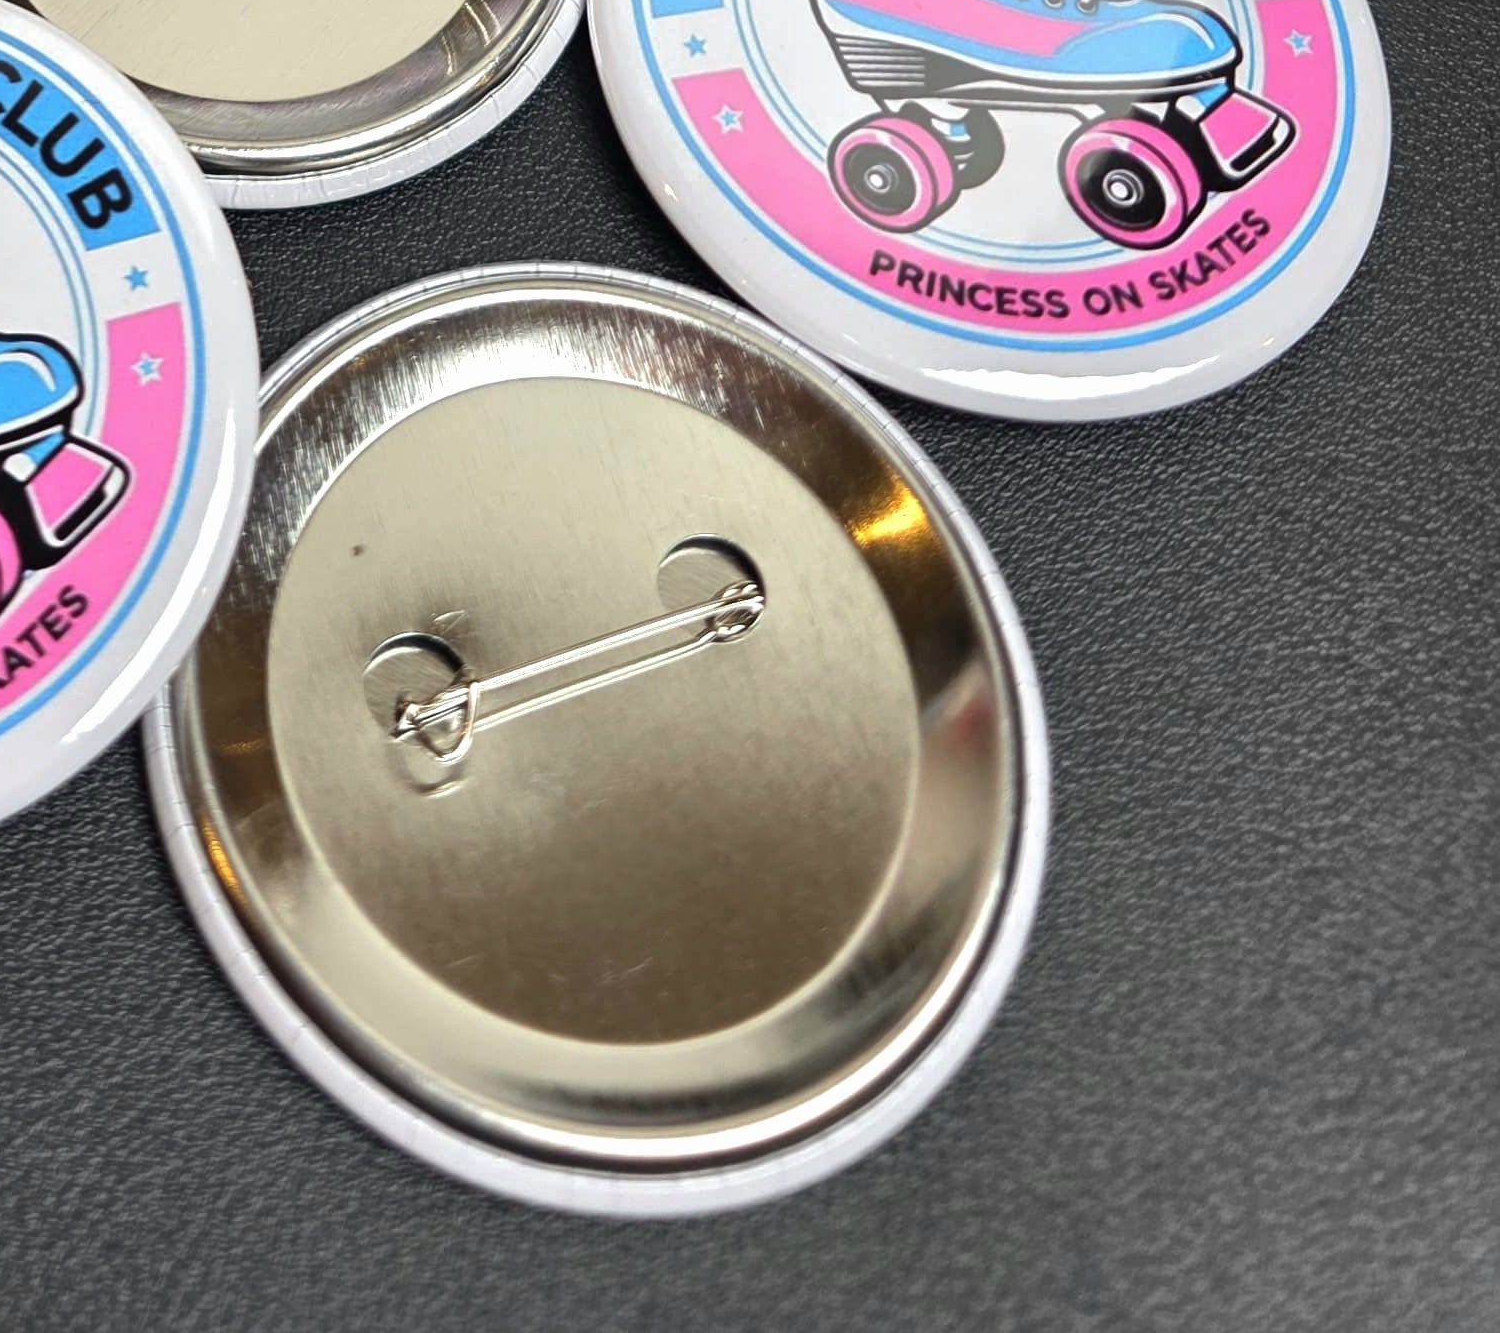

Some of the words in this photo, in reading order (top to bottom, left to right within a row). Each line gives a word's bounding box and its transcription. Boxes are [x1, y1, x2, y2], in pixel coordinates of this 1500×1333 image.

[868, 249, 1072, 320] PRINCESS
[1082, 286, 1145, 319] ON
[1155, 205, 1273, 303] SKATES
